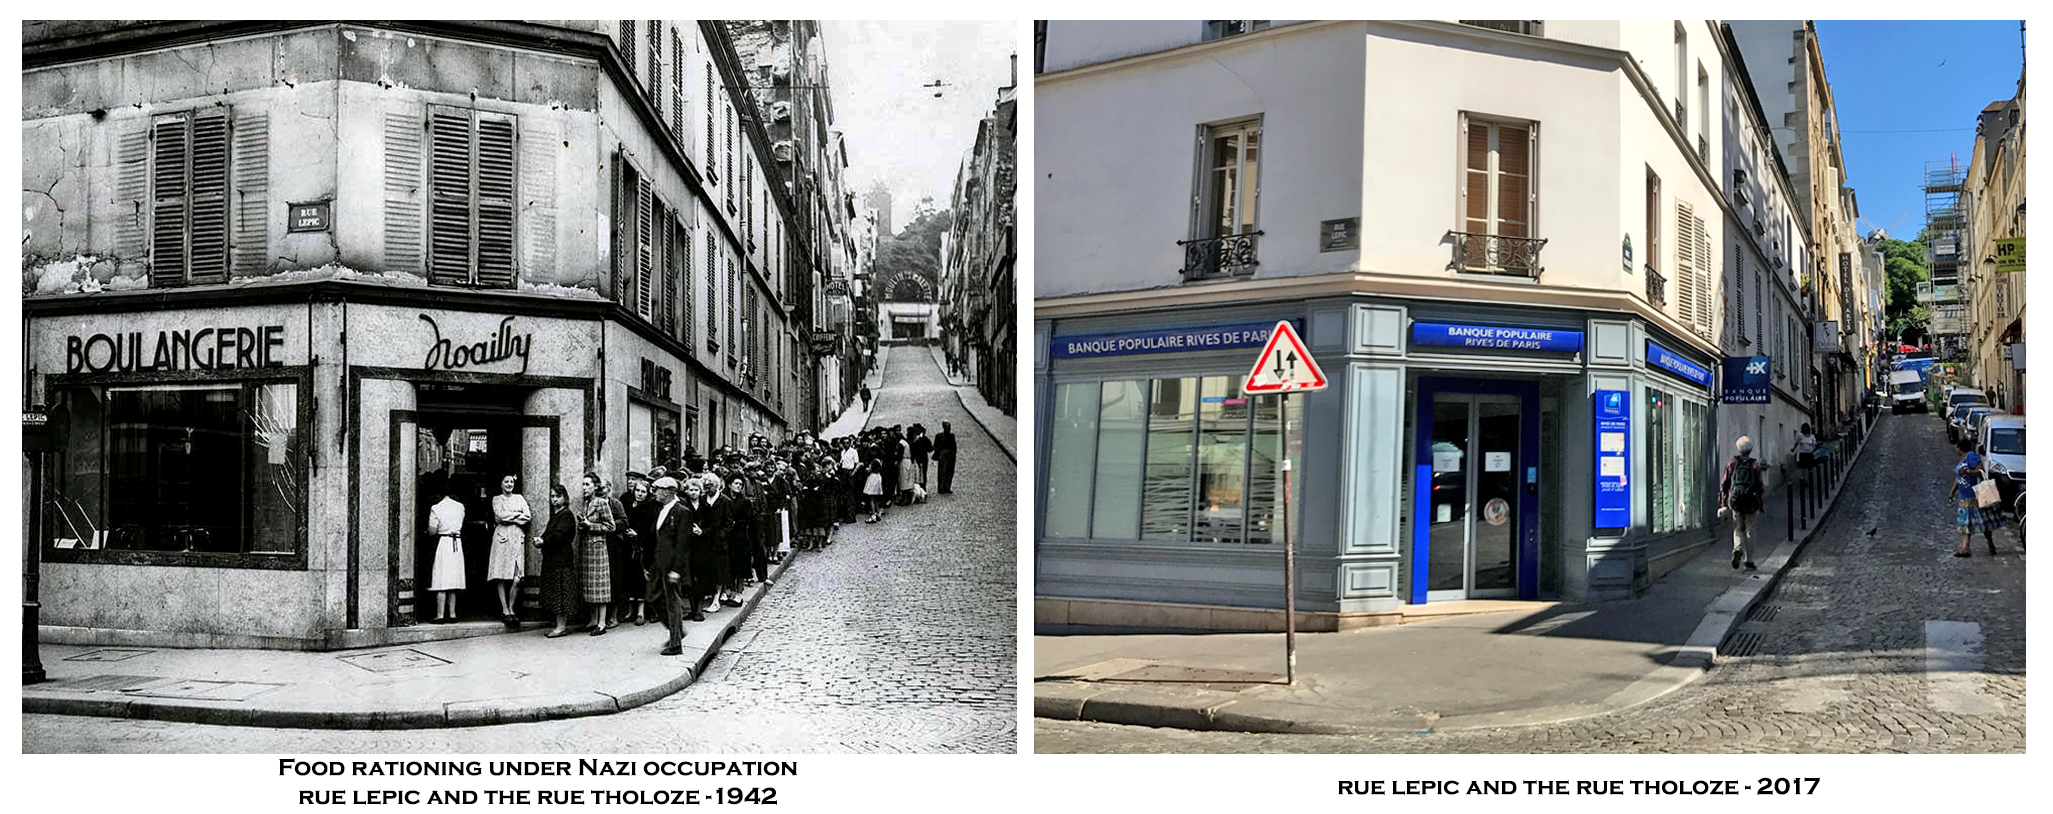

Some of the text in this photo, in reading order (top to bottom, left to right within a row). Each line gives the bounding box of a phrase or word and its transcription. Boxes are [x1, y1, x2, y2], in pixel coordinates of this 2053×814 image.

[301, 208, 317, 216] RUE
[299, 217, 320, 226] LEPIC
[1333, 223, 1346, 231] RUE
[1331, 231, 1347, 239] LEPIC
[1997, 243, 2015, 256] HP
[1842, 255, 1850, 284] HOTEL
[1448, 327, 1552, 341] BANQUE POPULAIRE
[1068, 329, 1273, 354] BANQUE POPULAIRE RIVES DE PARI
[1465, 338, 1541, 350] RIVES DE PARIS
[67, 326, 284, 374] BOULANGERIE
